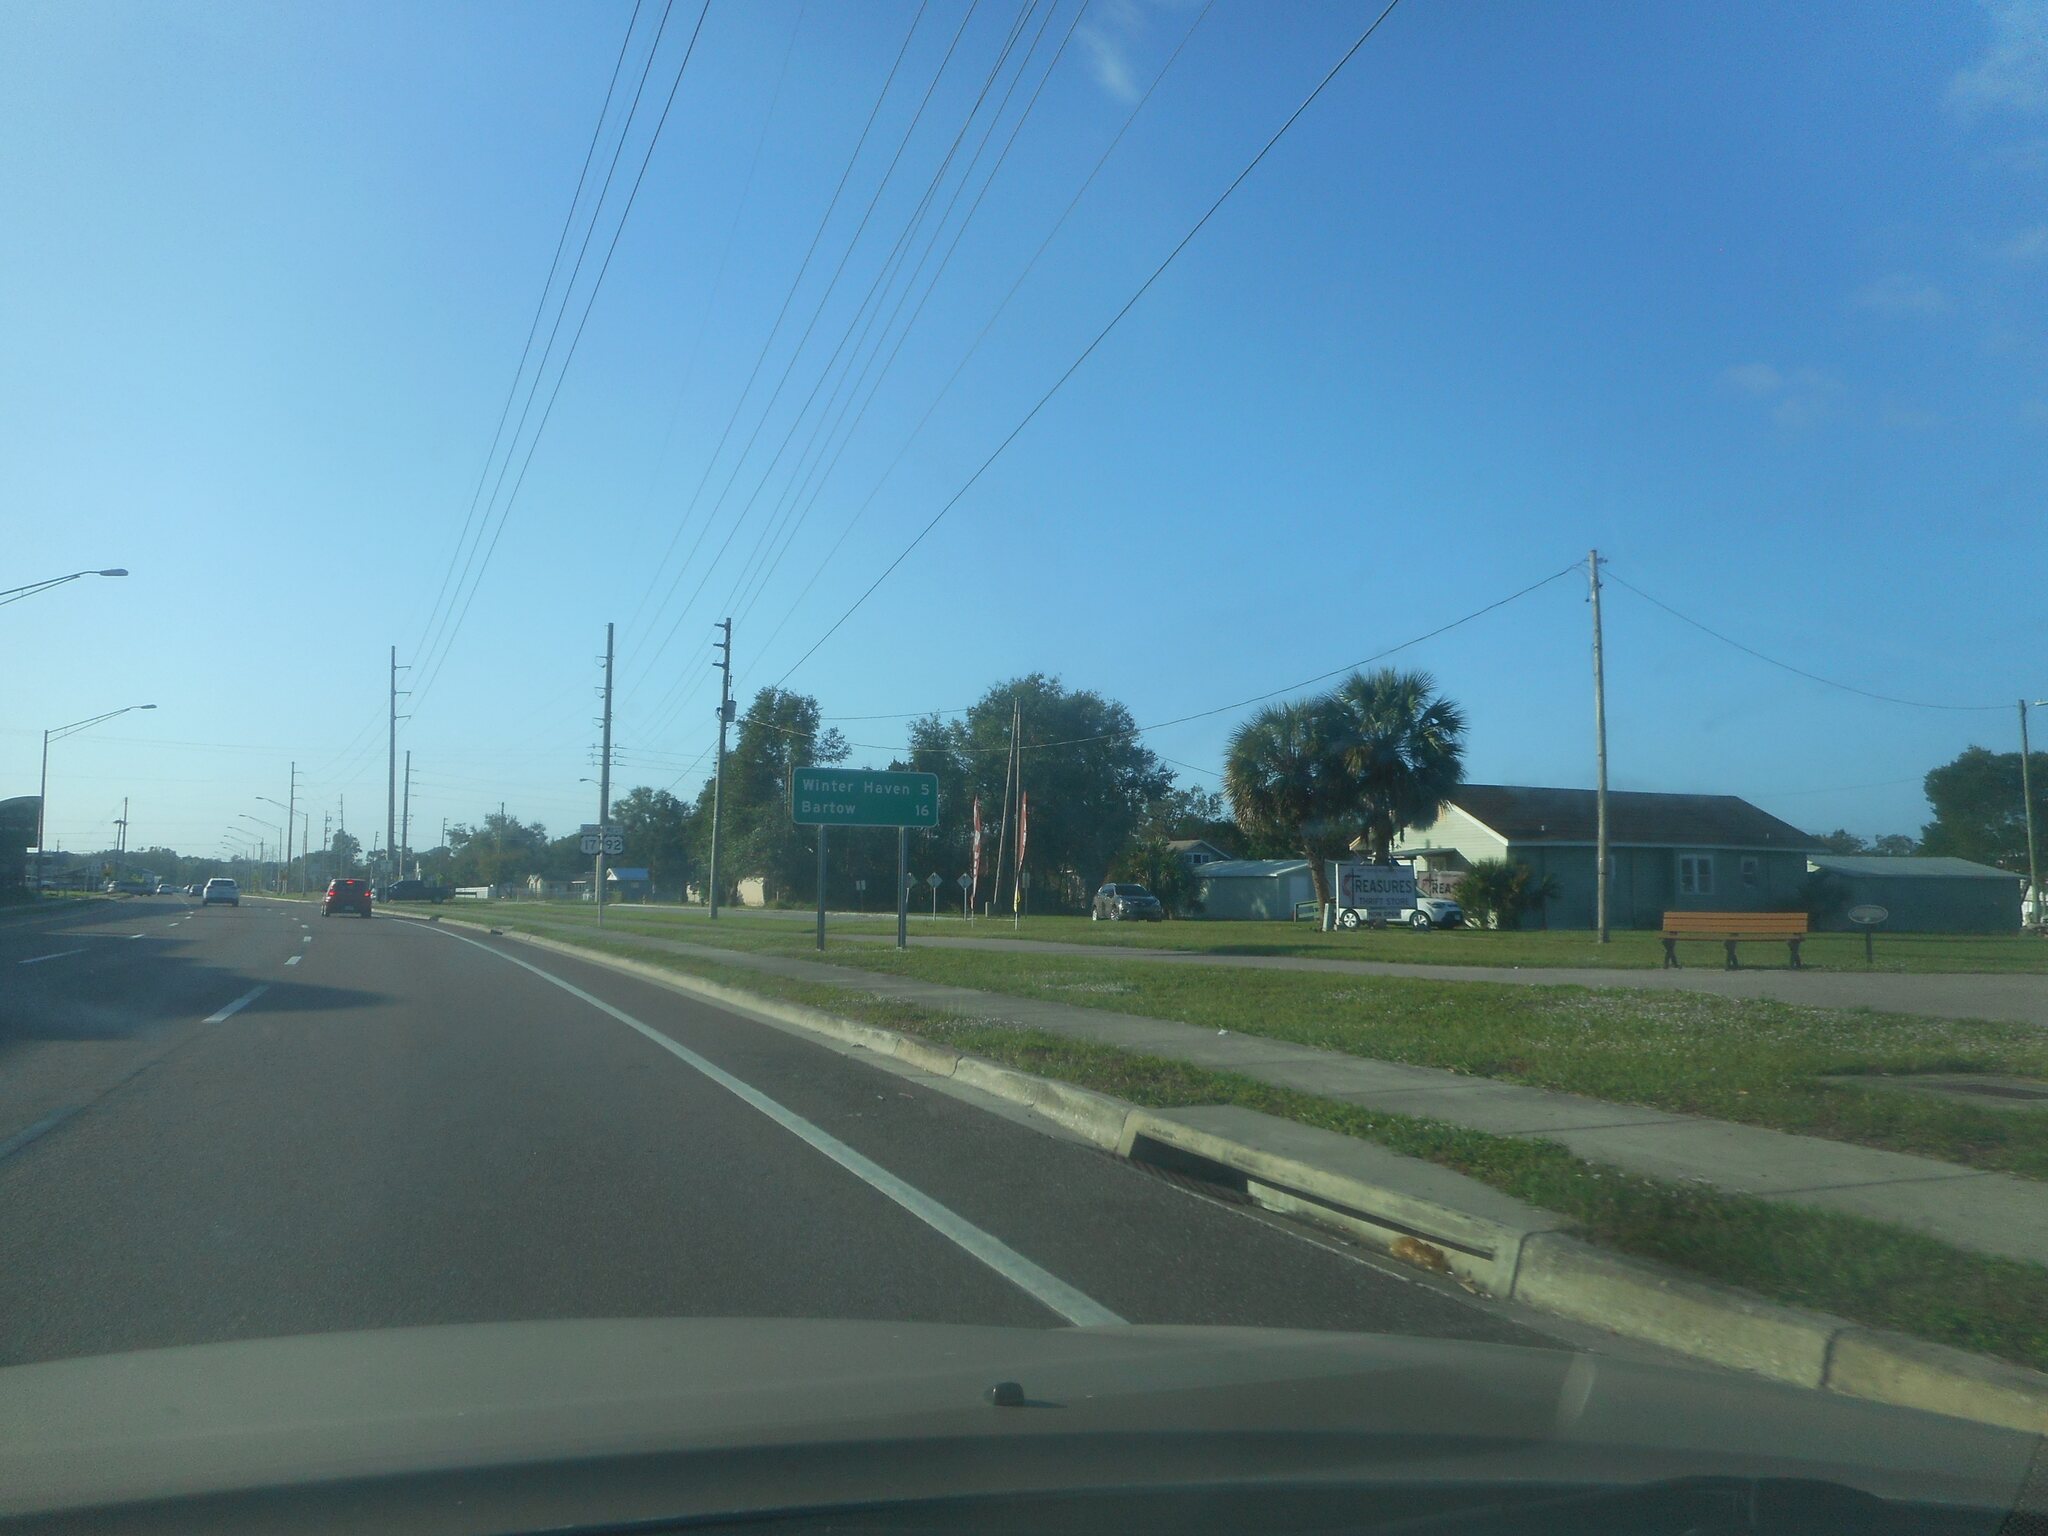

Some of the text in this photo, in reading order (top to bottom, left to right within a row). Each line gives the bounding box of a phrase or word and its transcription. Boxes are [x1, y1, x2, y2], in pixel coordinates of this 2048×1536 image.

[803, 778, 929, 796] Winter Haven 5
[801, 800, 929, 817] Bartow 16
[585, 839, 597, 850] 17
[606, 839, 621, 850] 92
